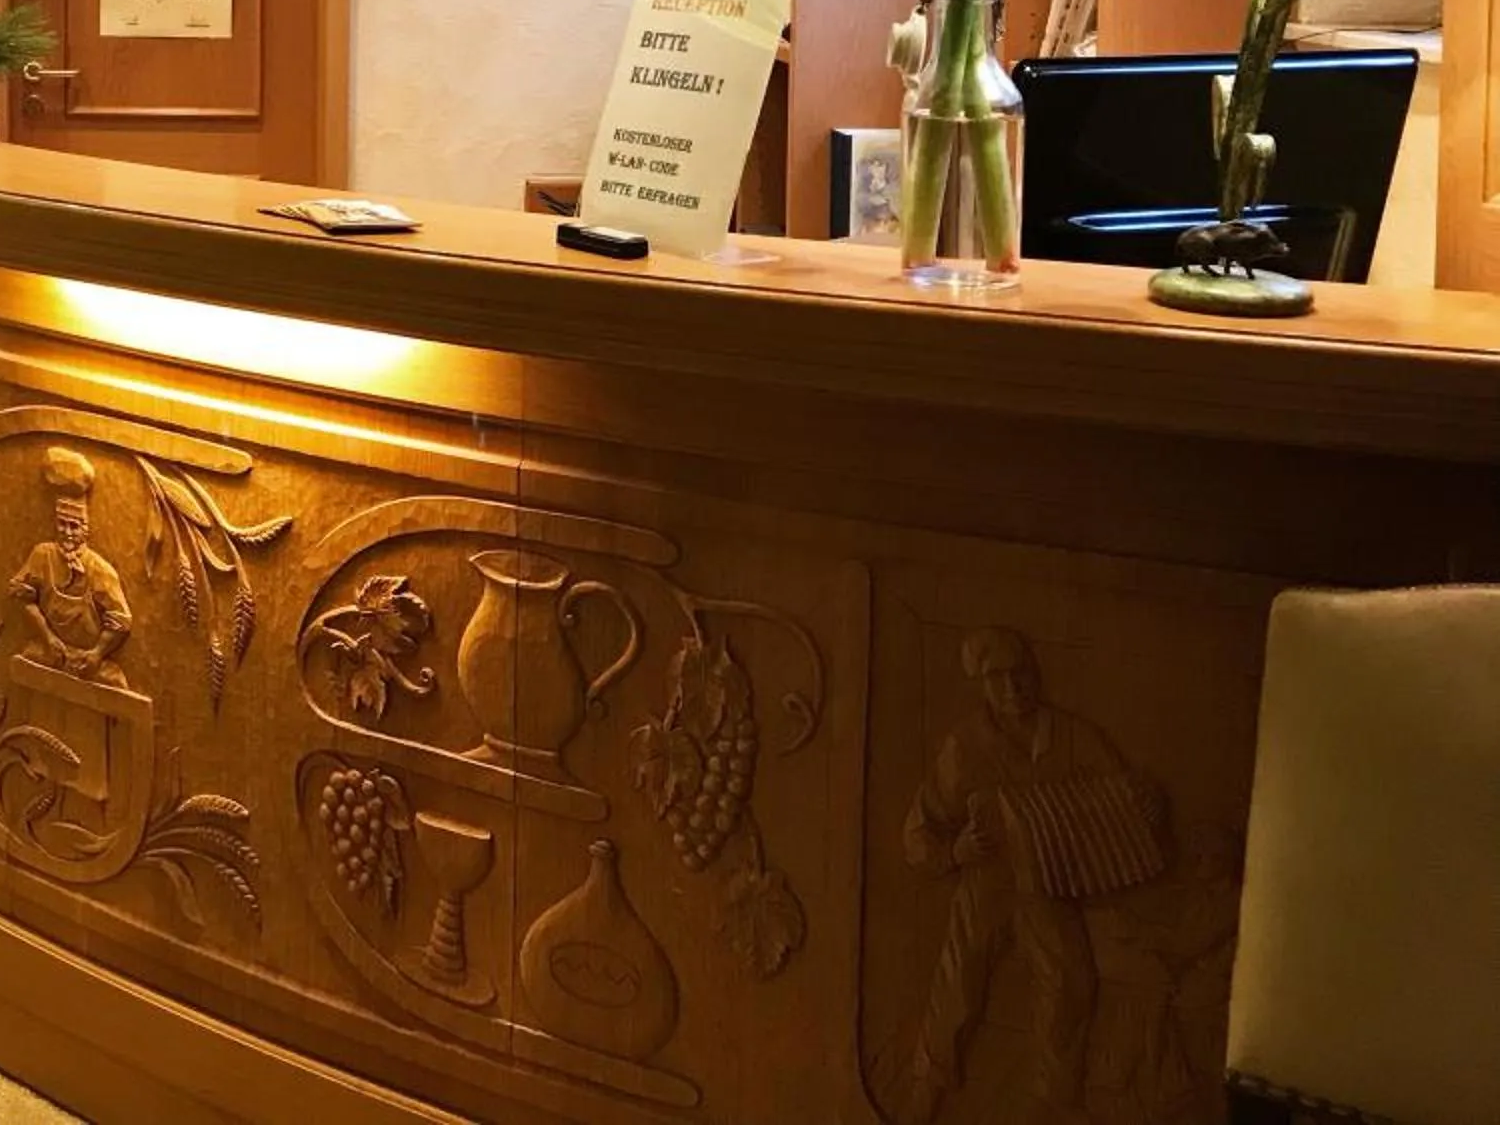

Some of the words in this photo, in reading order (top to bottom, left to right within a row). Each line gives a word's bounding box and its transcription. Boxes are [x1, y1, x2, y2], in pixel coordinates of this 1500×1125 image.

[640, 30, 691, 52] BITTE
[629, 66, 714, 93] KLINGELN
[613, 128, 693, 153] KOSTENLOSER
[600, 180, 634, 196] BITTE
[637, 186, 700, 210] ERFRAGEN
